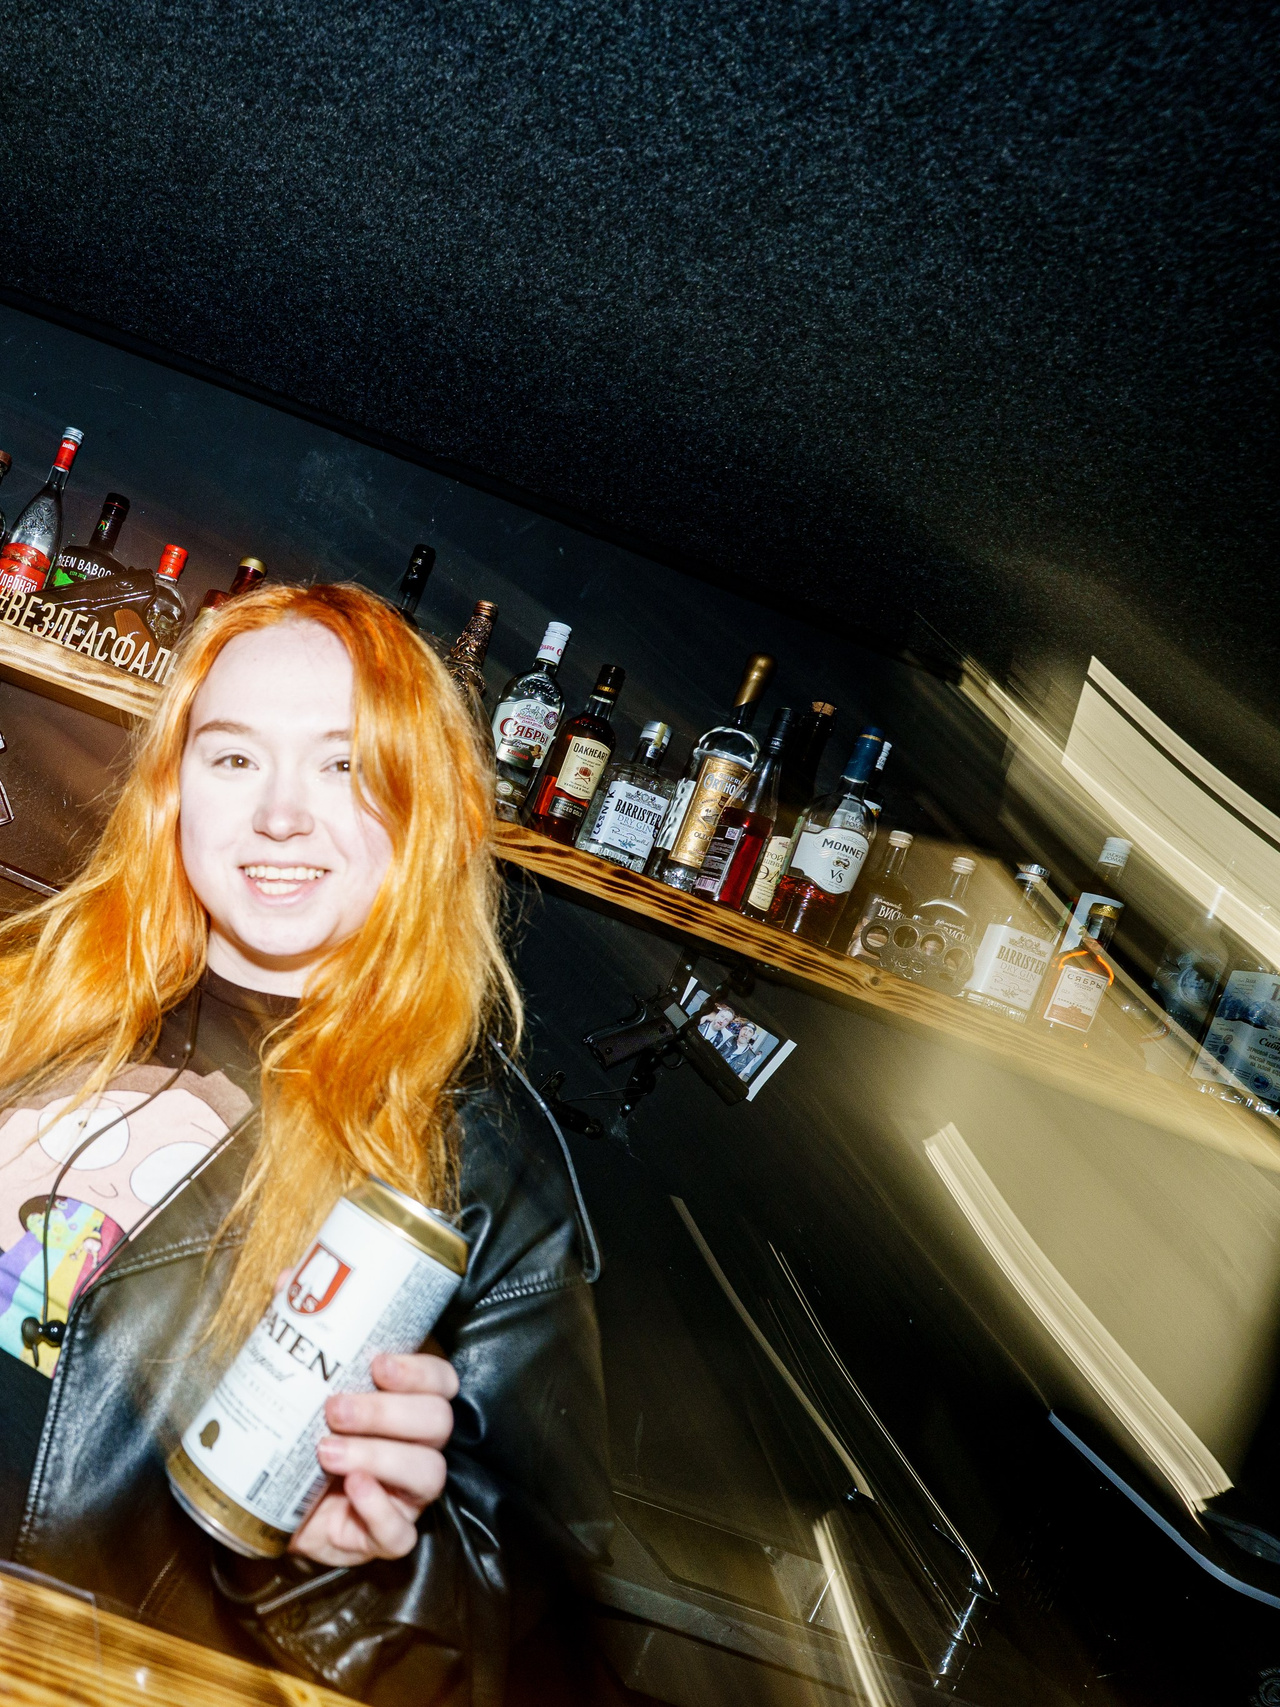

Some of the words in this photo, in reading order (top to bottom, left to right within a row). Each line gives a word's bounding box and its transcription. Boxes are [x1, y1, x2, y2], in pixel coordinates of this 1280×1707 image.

[573, 742, 608, 762] OAKHEART
[614, 798, 662, 828] BARRISTER
[617, 814, 636, 827] DRY
[636, 821, 653, 833] GIN
[822, 838, 865, 860] MONNET
[830, 869, 844, 883] VS
[996, 945, 1047, 977] BARRISTER
[1000, 961, 1018, 974] DRY
[1020, 968, 1037, 982] GIN
[1067, 973, 1104, 990] СЯБРЫ
[263, 1311, 341, 1382] ATEN
